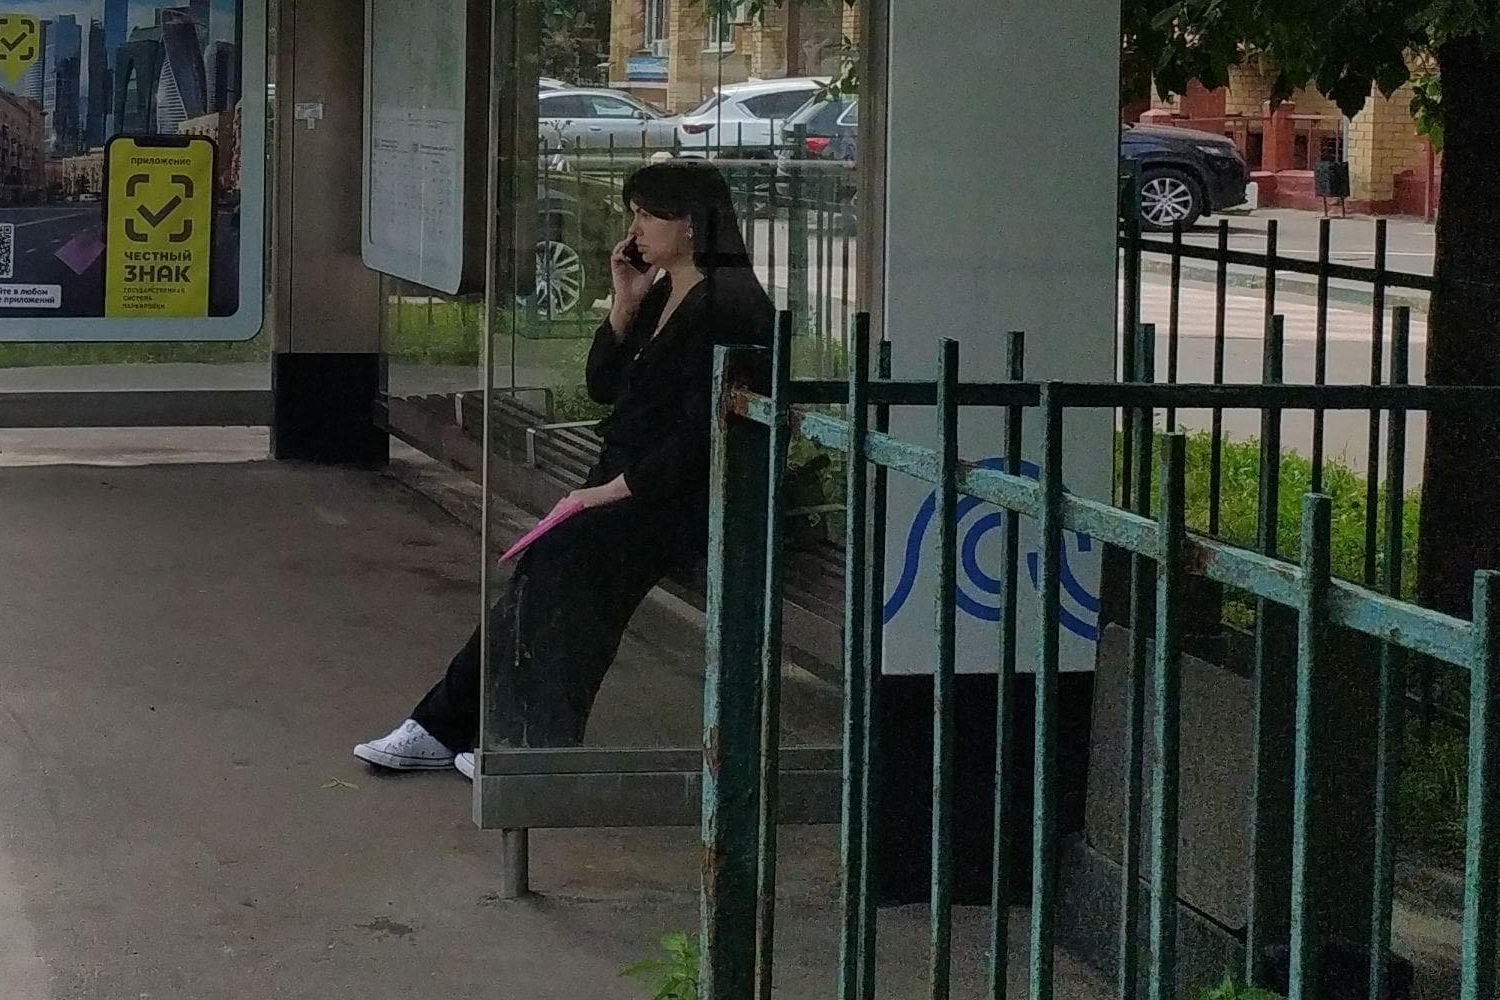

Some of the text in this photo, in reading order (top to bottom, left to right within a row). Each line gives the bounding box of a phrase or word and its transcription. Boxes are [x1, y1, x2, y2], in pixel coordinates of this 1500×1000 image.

[130, 156, 192, 167] приложение
[124, 249, 192, 262] ЧЕСТНЫЙ
[123, 264, 192, 283] ЗНАК
[20, 287, 49, 296] любом
[4, 296, 56, 305] приложений
